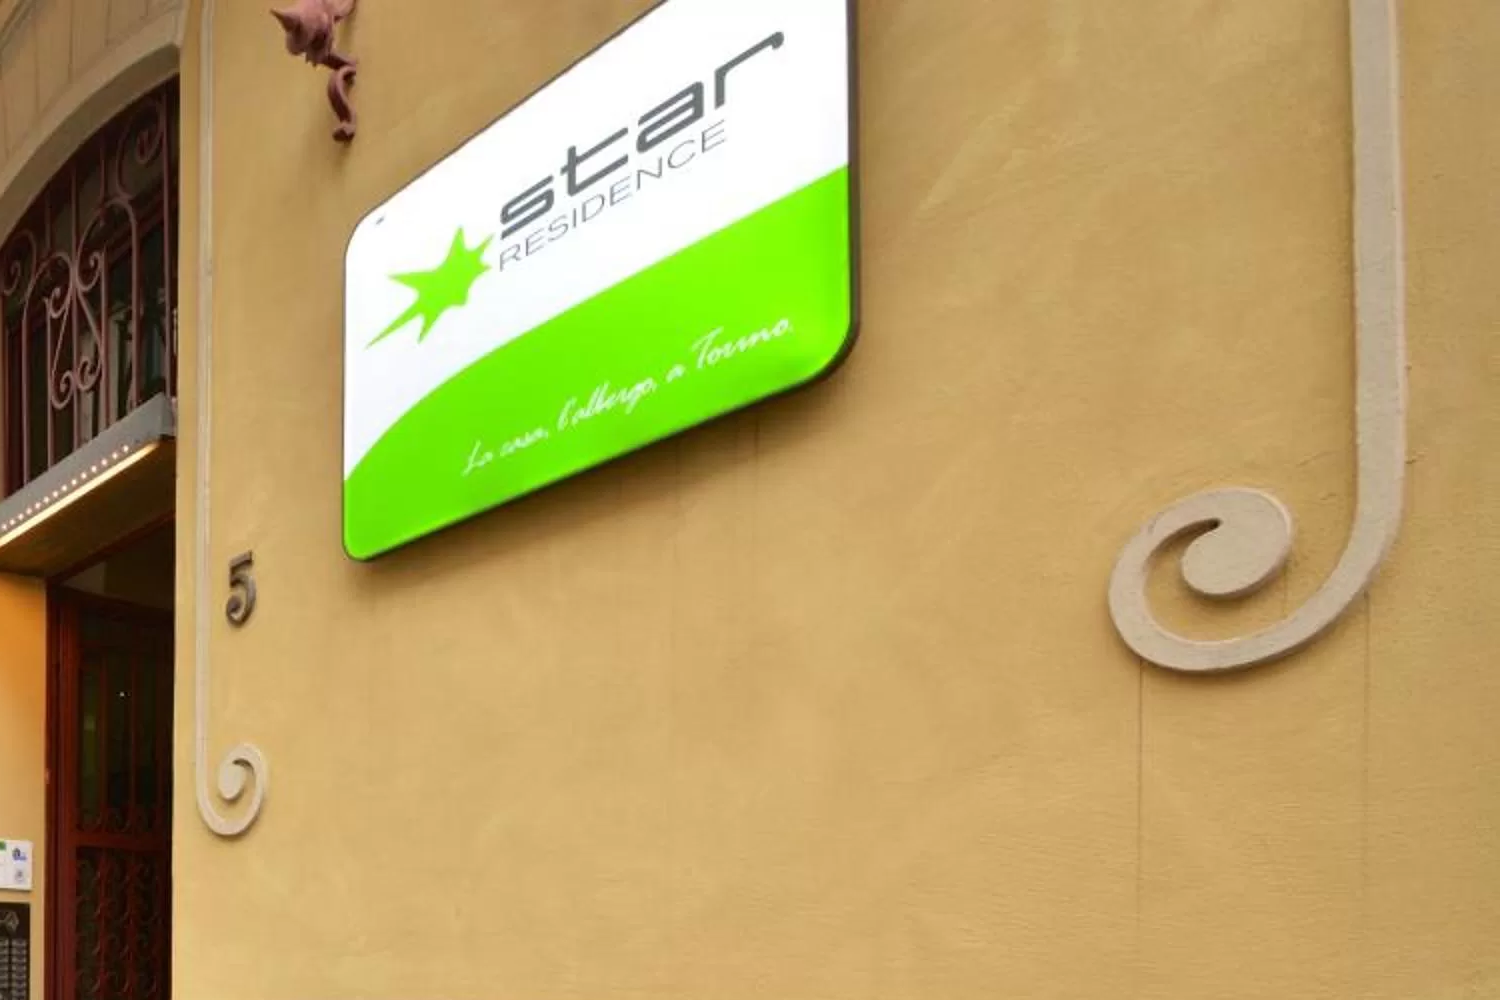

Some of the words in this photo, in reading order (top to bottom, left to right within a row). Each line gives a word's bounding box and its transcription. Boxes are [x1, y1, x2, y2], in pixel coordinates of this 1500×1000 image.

[499, 118, 727, 272] RESIDENCE
[500, 31, 785, 241] star
[226, 549, 257, 630] 5
